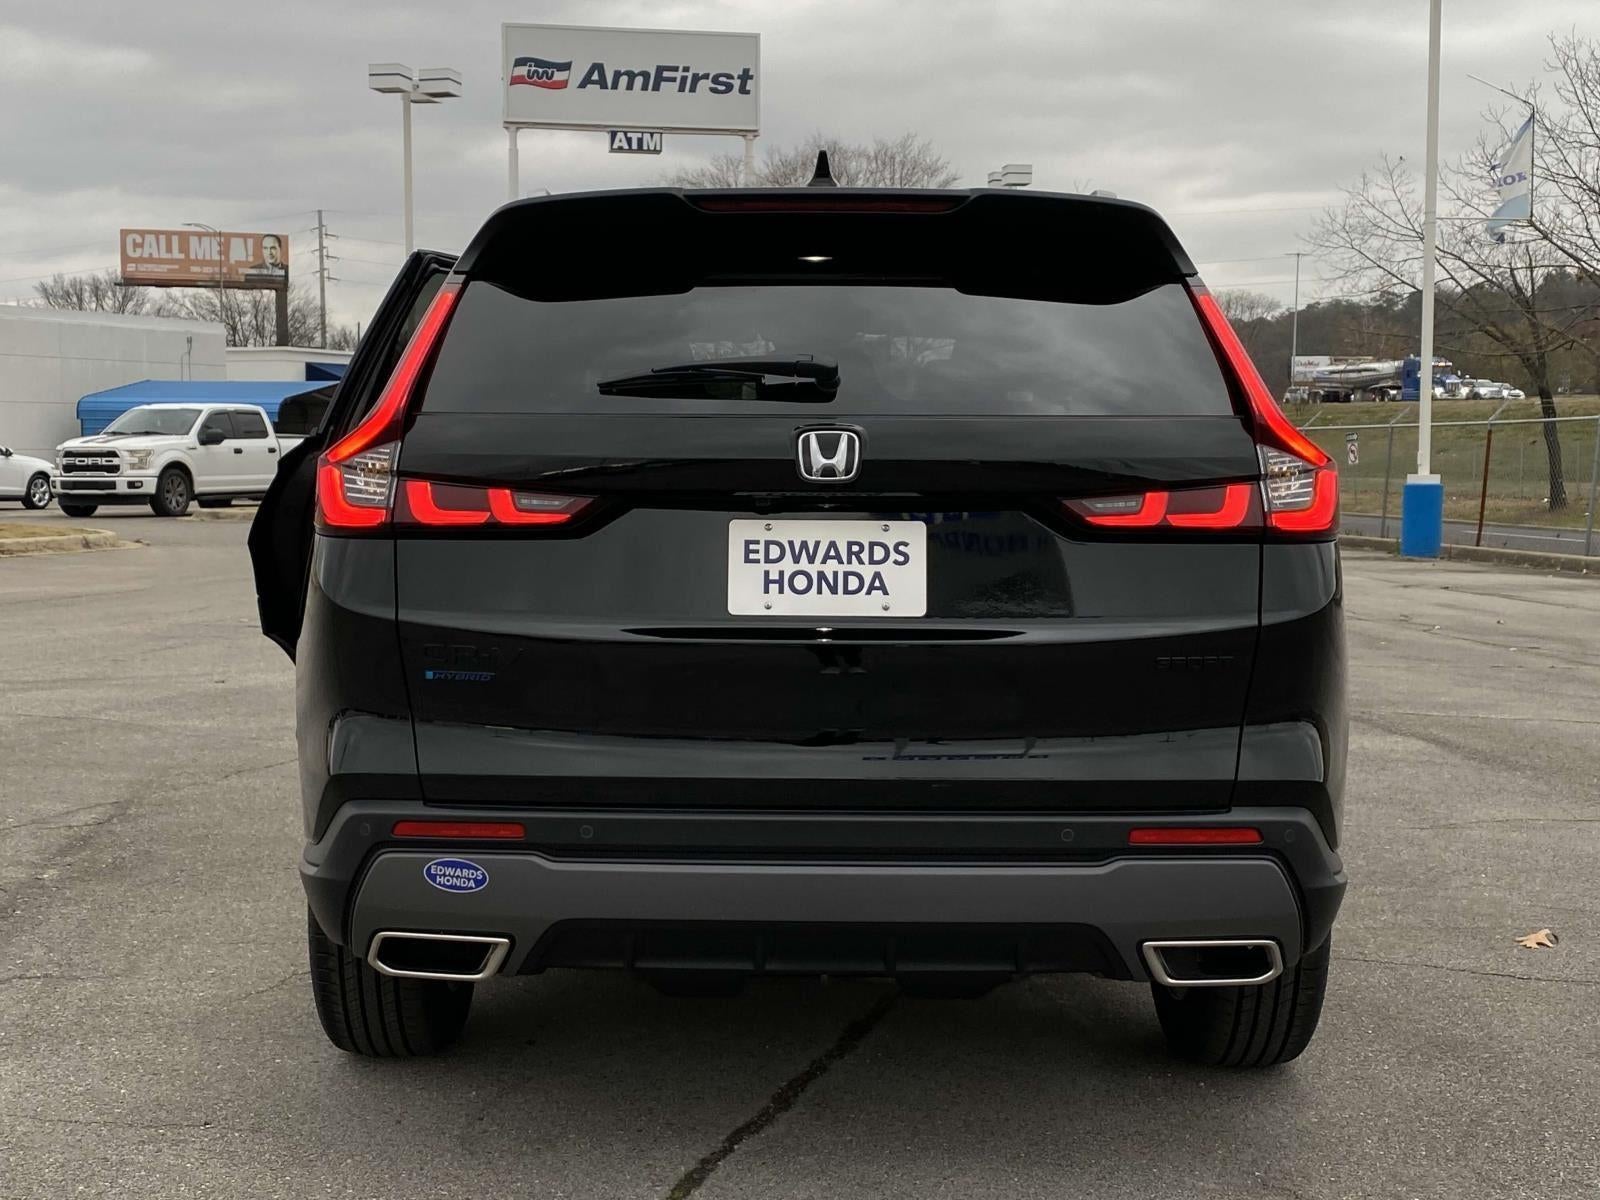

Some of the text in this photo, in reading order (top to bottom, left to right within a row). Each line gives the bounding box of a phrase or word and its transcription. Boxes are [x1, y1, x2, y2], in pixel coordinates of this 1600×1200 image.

[576, 62, 754, 95] AmFirst
[611, 131, 662, 151] ATM
[125, 233, 185, 259] CALL
[189, 235, 225, 261] ME
[63, 457, 115, 465] FORD
[743, 539, 911, 566] EDWARDS
[763, 569, 890, 596] HONDA
[433, 671, 495, 681] HYBRID
[430, 864, 483, 880] EDWARDS
[436, 875, 476, 888] HONDA
